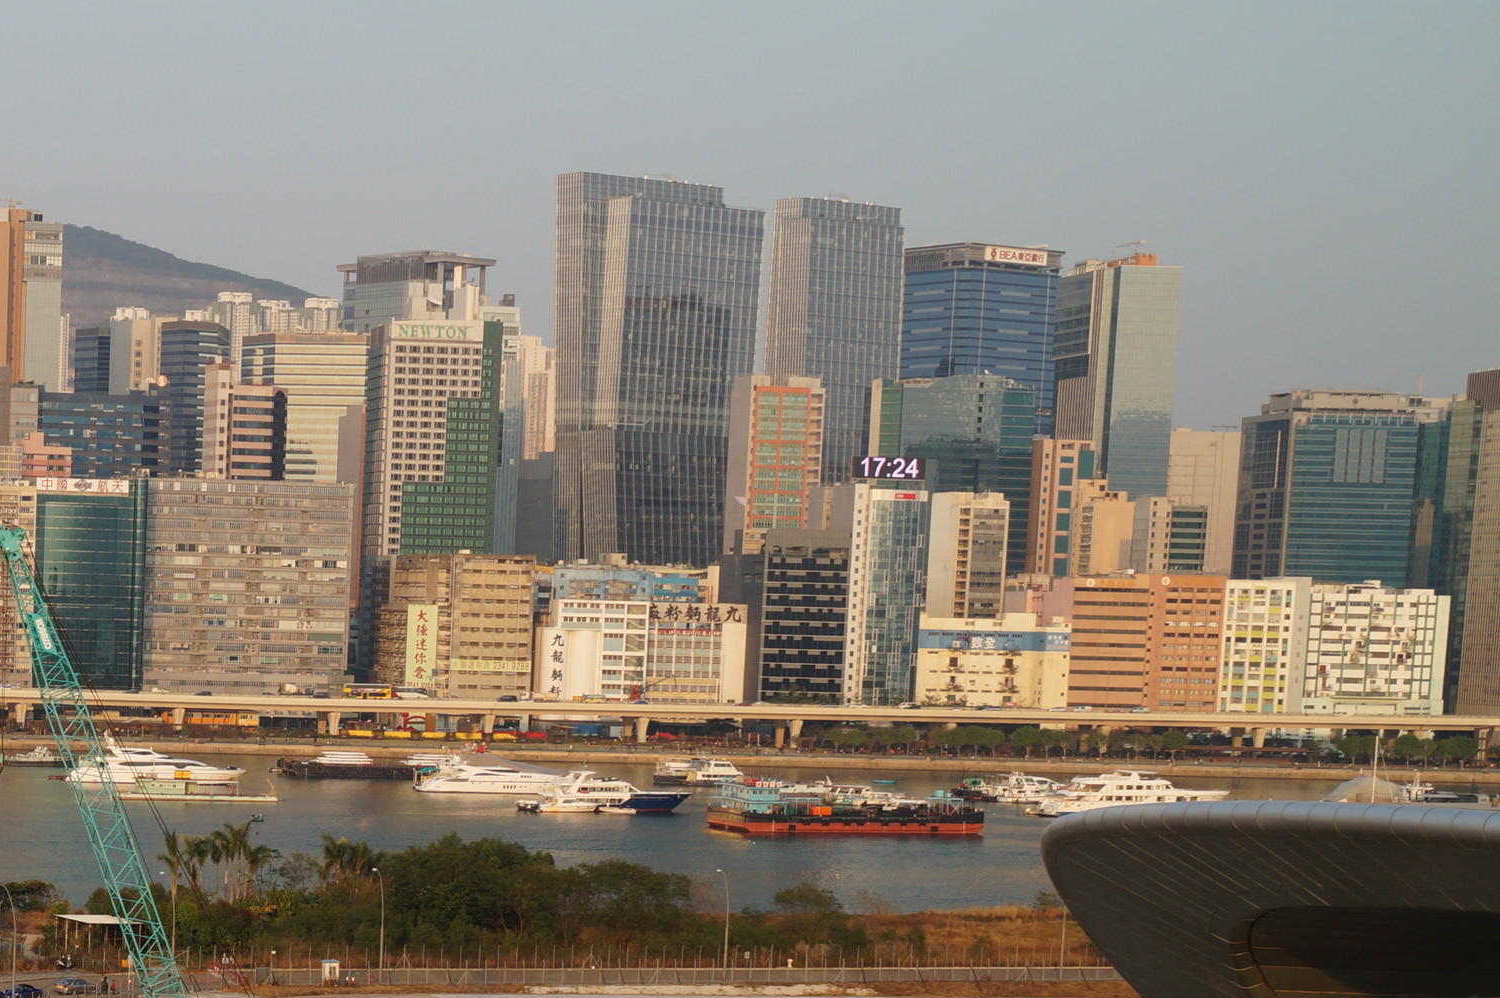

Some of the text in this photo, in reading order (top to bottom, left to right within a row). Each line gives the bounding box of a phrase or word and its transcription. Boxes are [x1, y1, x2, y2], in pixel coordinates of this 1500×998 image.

[1000, 250, 1017, 260] BEA
[398, 325, 469, 339] NEWTON
[860, 457, 919, 478] 17:24
[41, 479, 68, 491] 中國
[96, 479, 124, 492] 航天
[493, 661, 509, 670] 2341
[512, 662, 530, 671] 9288
